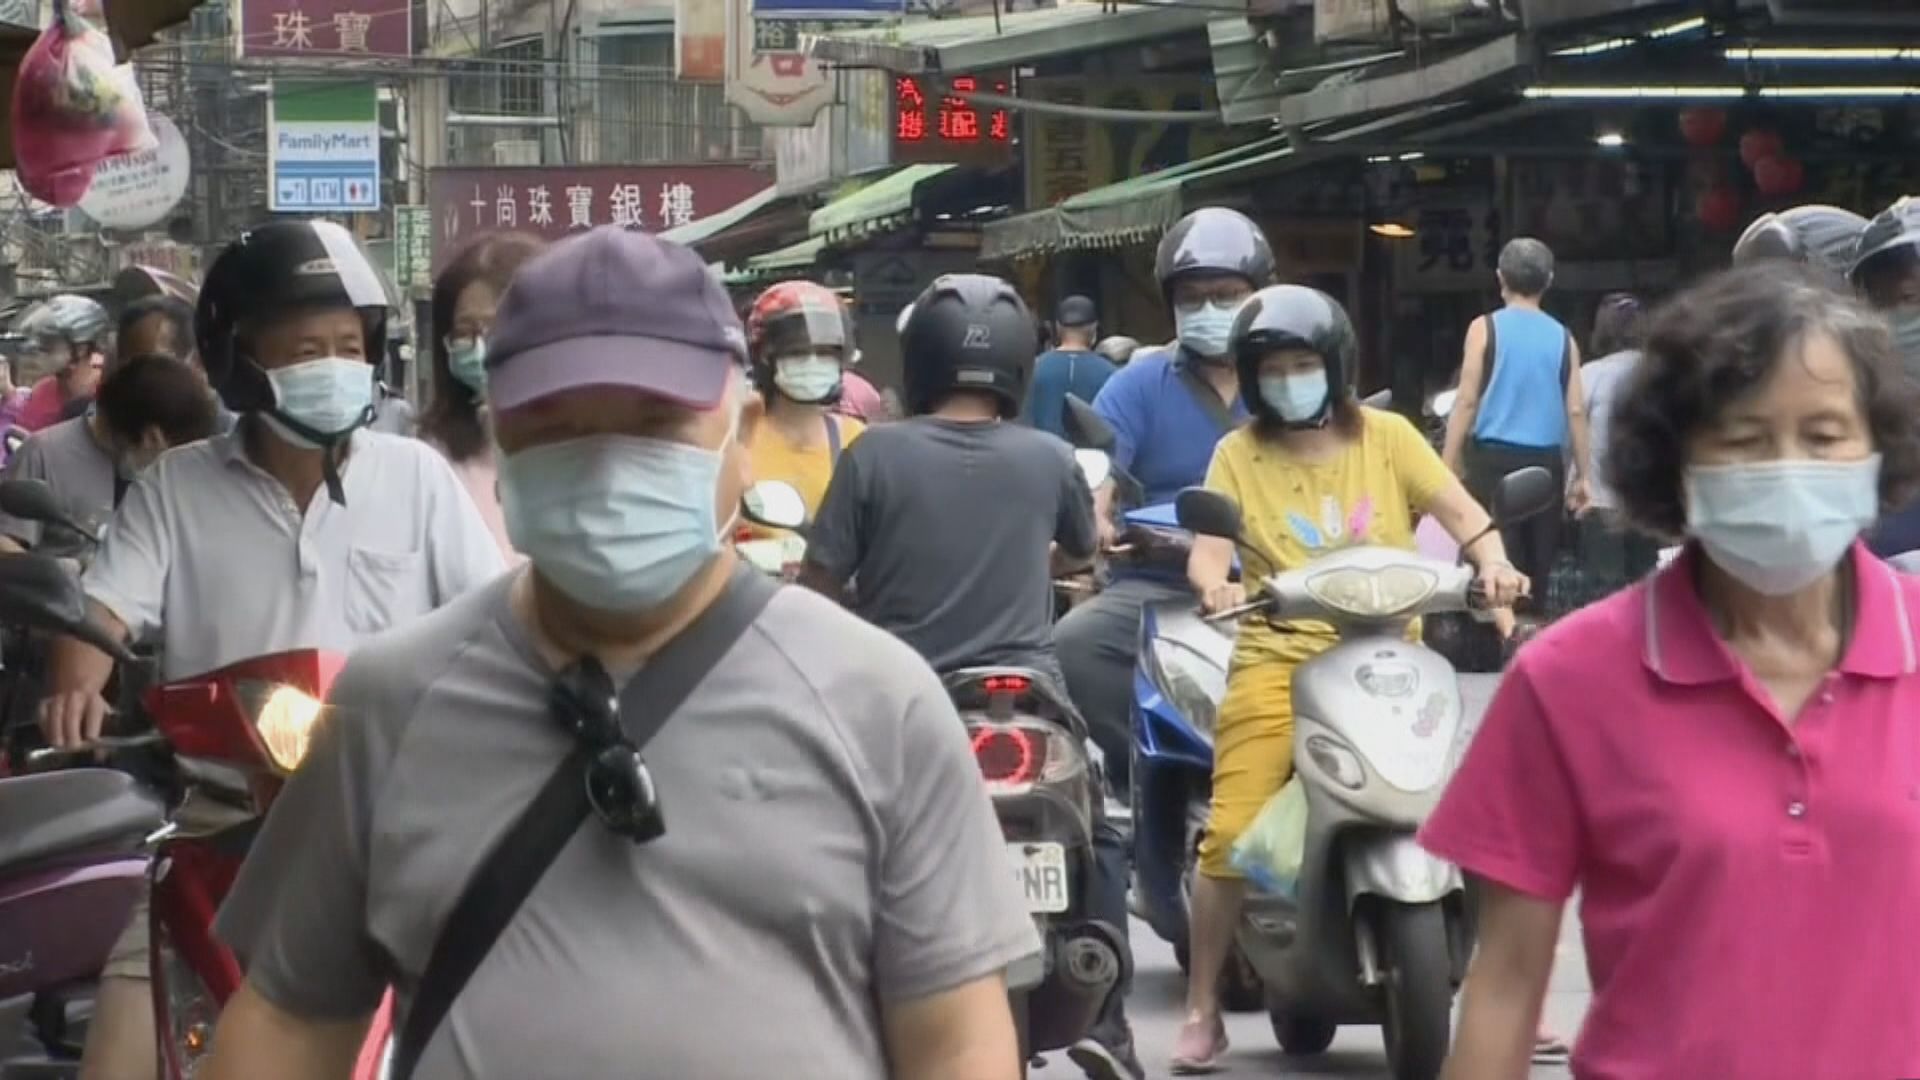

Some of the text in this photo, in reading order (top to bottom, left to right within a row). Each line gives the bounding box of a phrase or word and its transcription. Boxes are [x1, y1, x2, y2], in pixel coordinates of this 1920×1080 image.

[271, 10, 372, 51] 珠寶
[279, 133, 369, 152] FamilyMart
[314, 182, 338, 201] ATM
[470, 182, 695, 228] 十尚珠寶銀樓
[1015, 866, 1063, 900] NR
